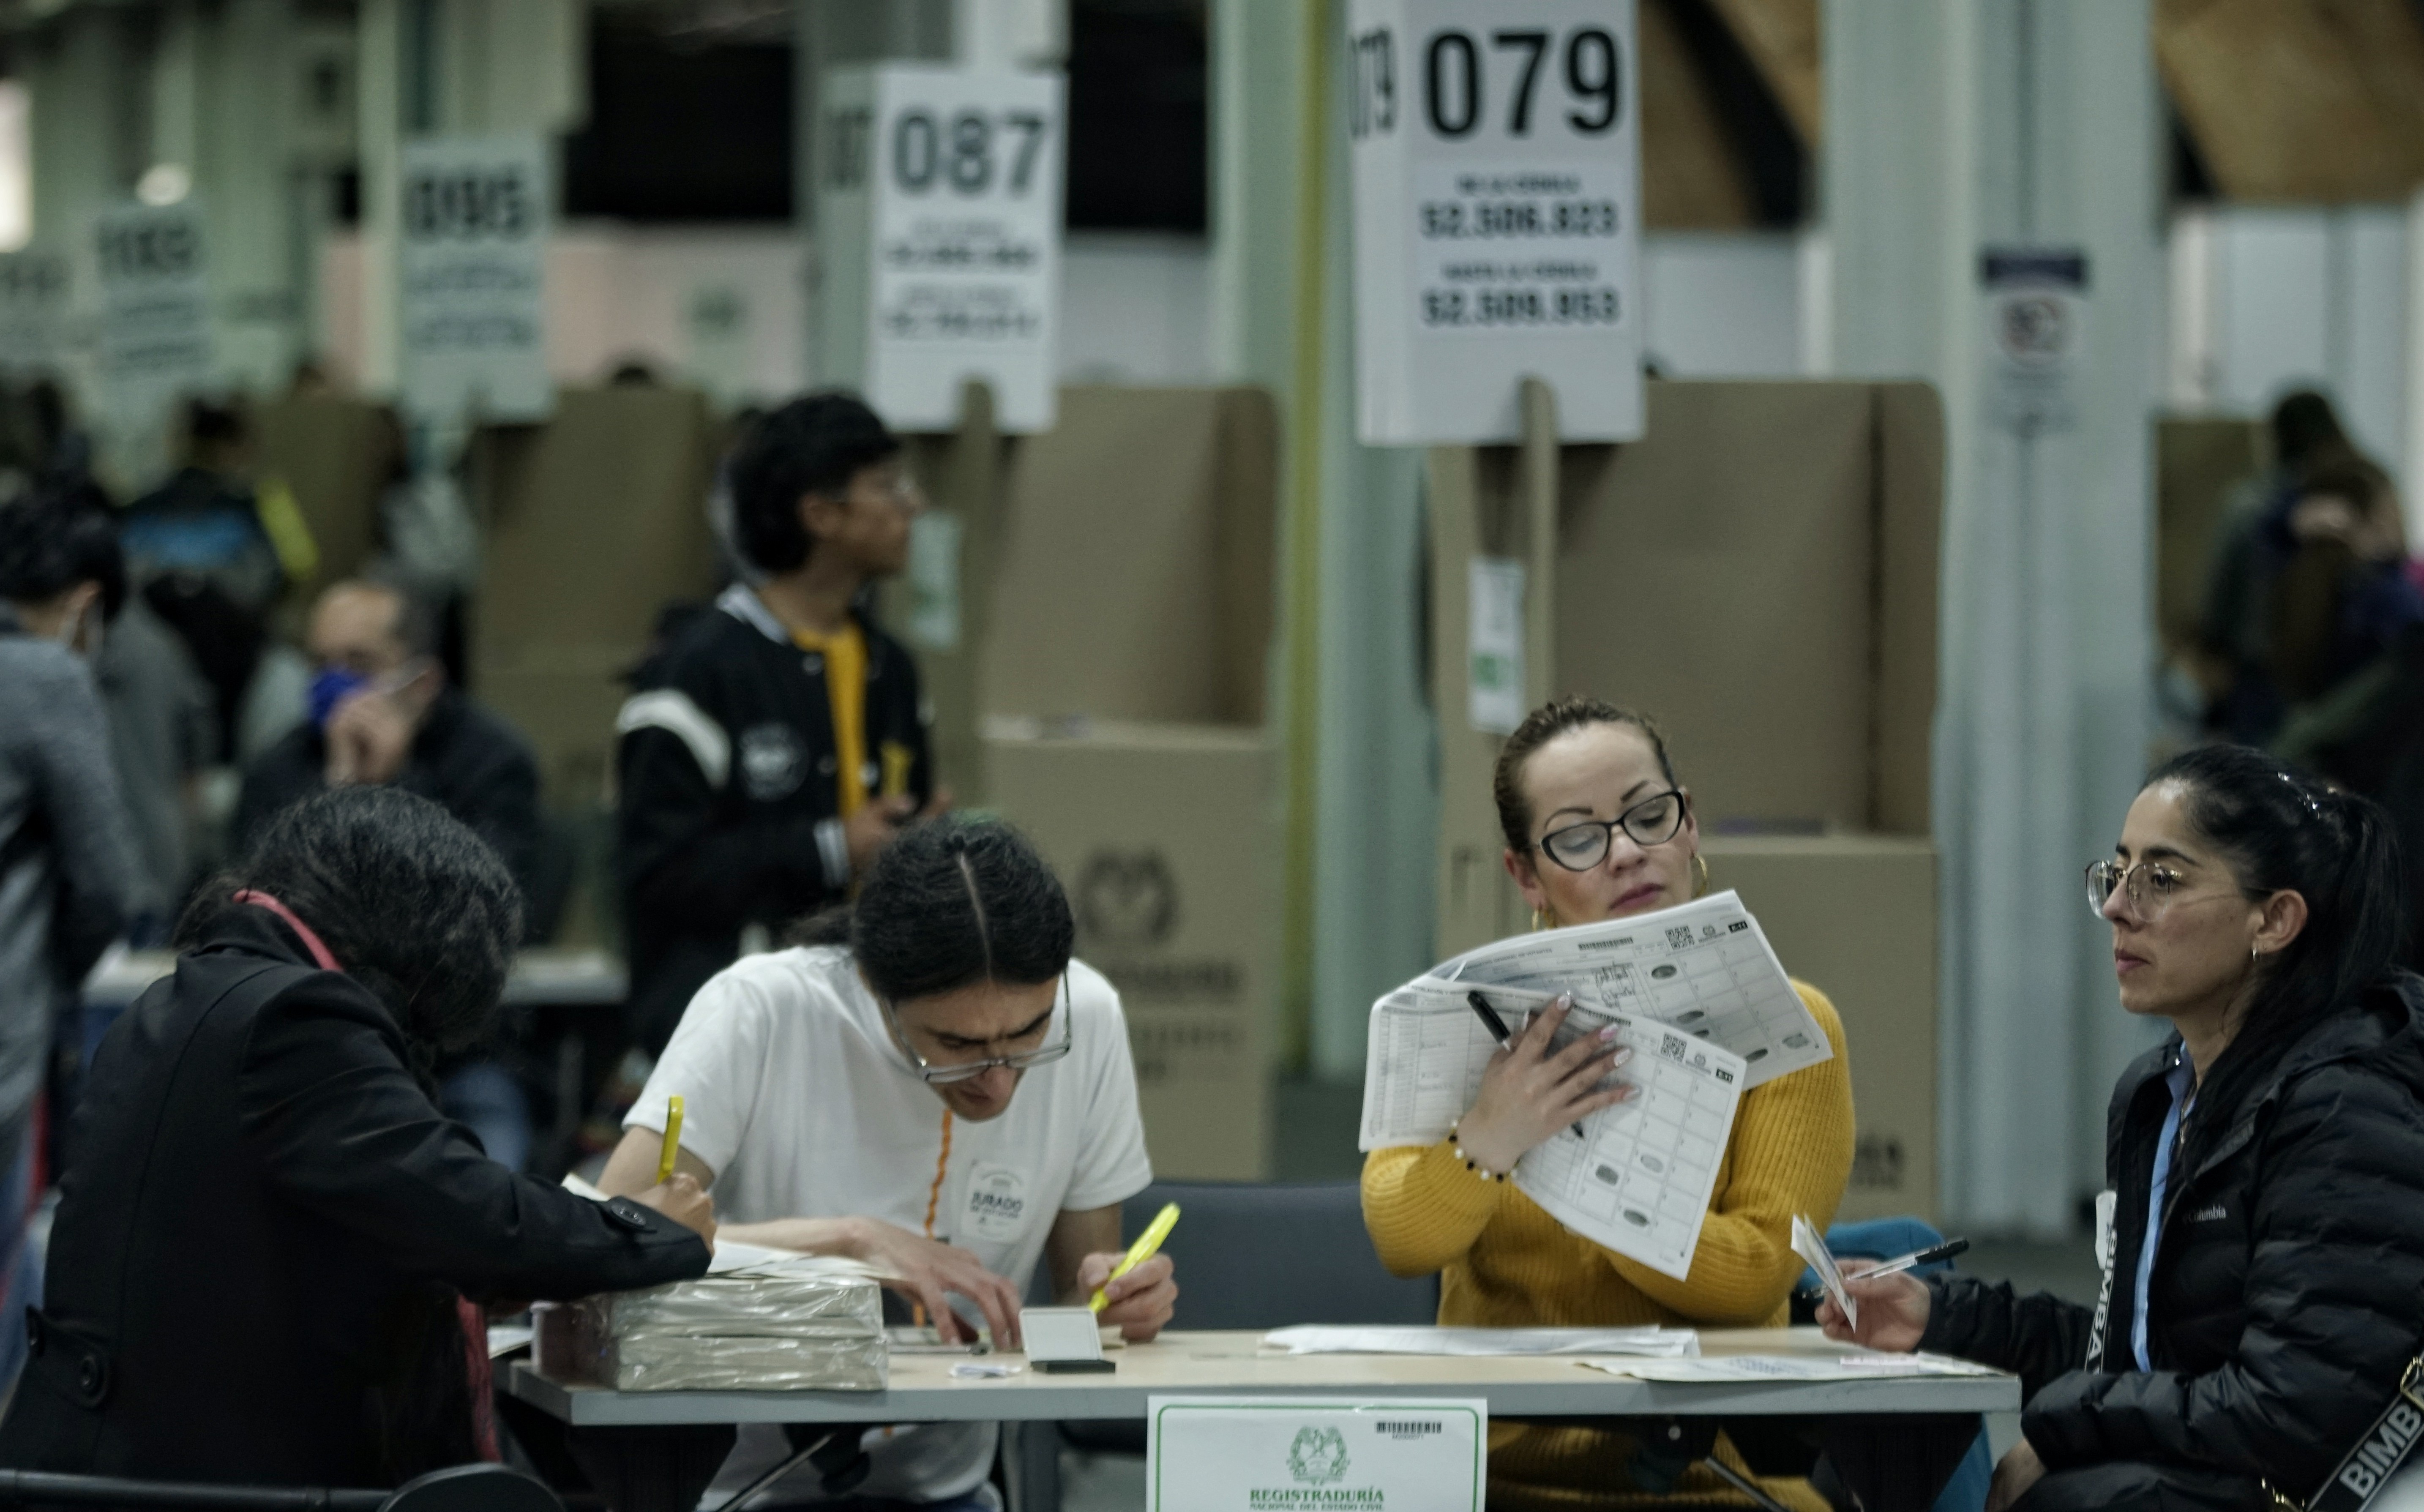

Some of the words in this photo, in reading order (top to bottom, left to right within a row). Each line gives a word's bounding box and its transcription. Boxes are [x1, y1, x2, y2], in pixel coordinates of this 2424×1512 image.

[1425, 30, 1620, 139] 079
[893, 107, 1046, 195] 087
[2188, 1204, 2227, 1223] Columbia
[1250, 1486, 1384, 1502] REGISTRADURÍA
